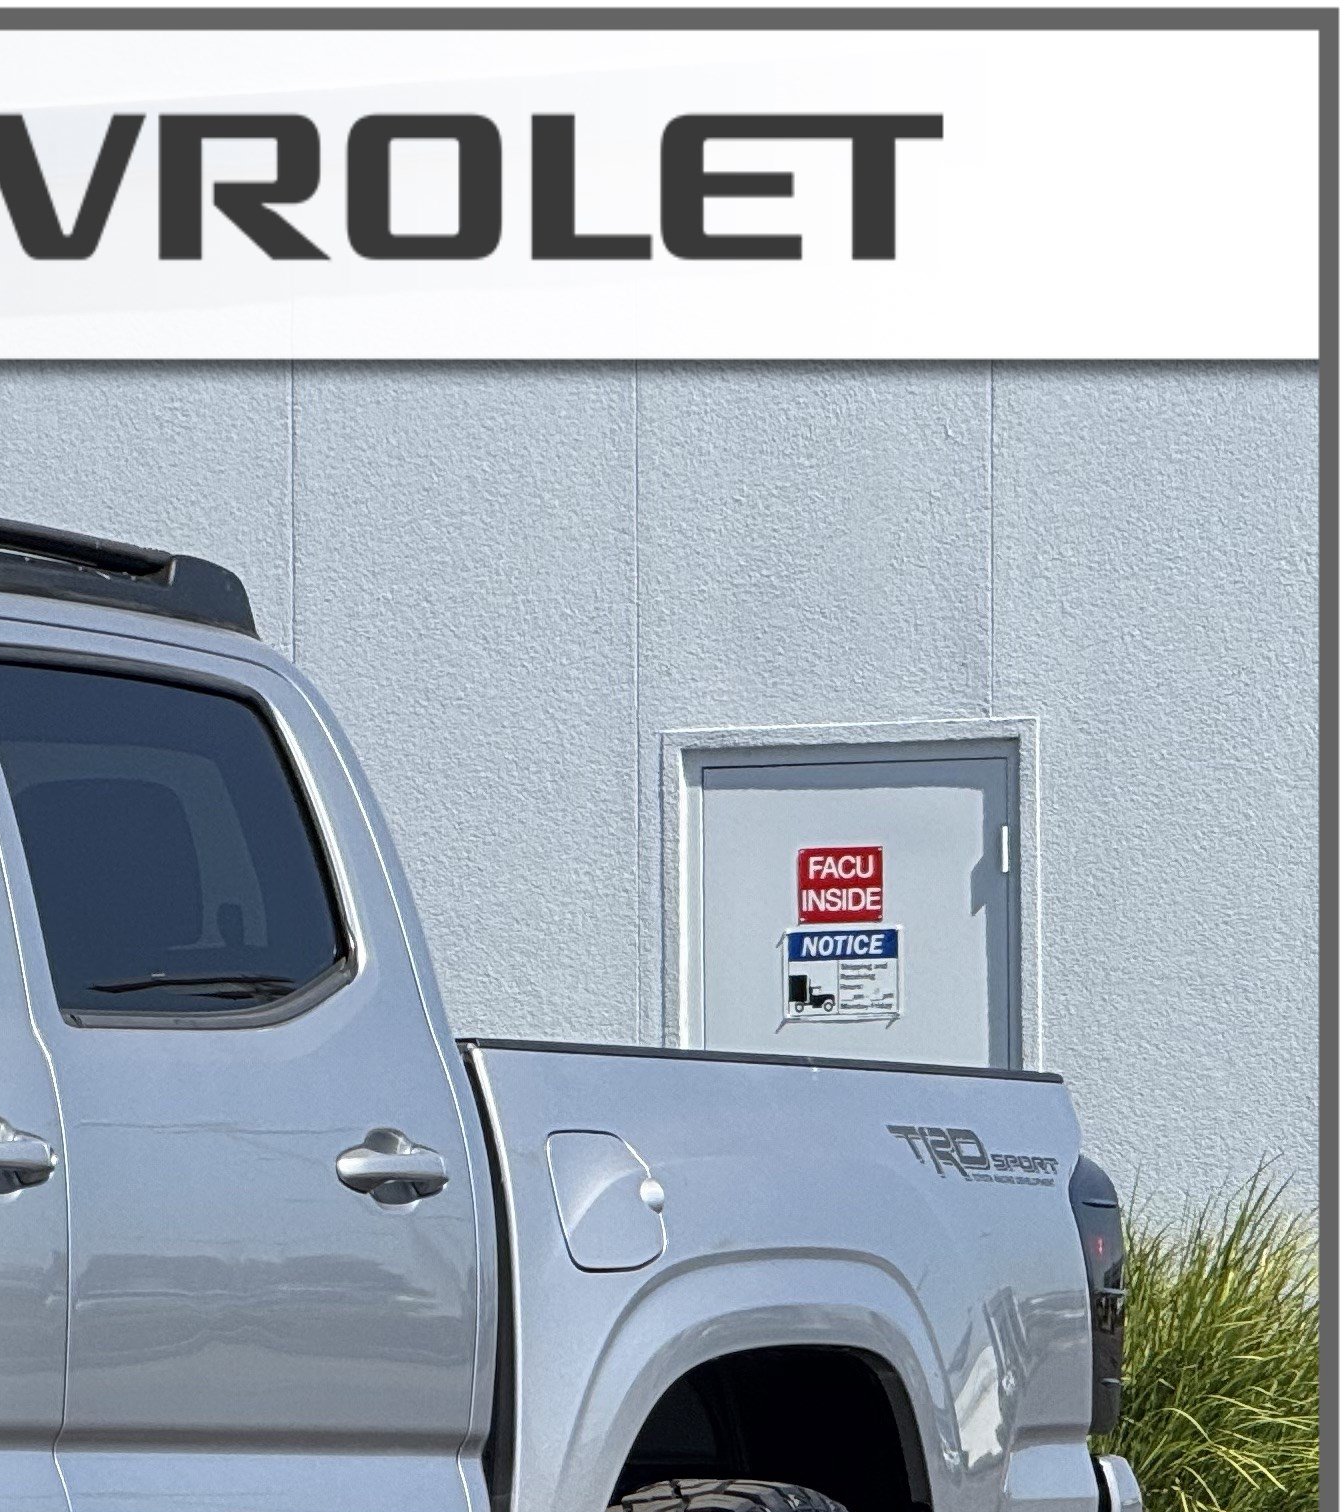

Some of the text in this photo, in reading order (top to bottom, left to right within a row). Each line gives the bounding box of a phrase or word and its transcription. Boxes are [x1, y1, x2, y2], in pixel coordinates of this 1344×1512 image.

[808, 854, 875, 880] FACU
[801, 887, 882, 912] INSIDE
[801, 934, 885, 957] NOTICE
[886, 1125, 1059, 1182] TRD SPORT
